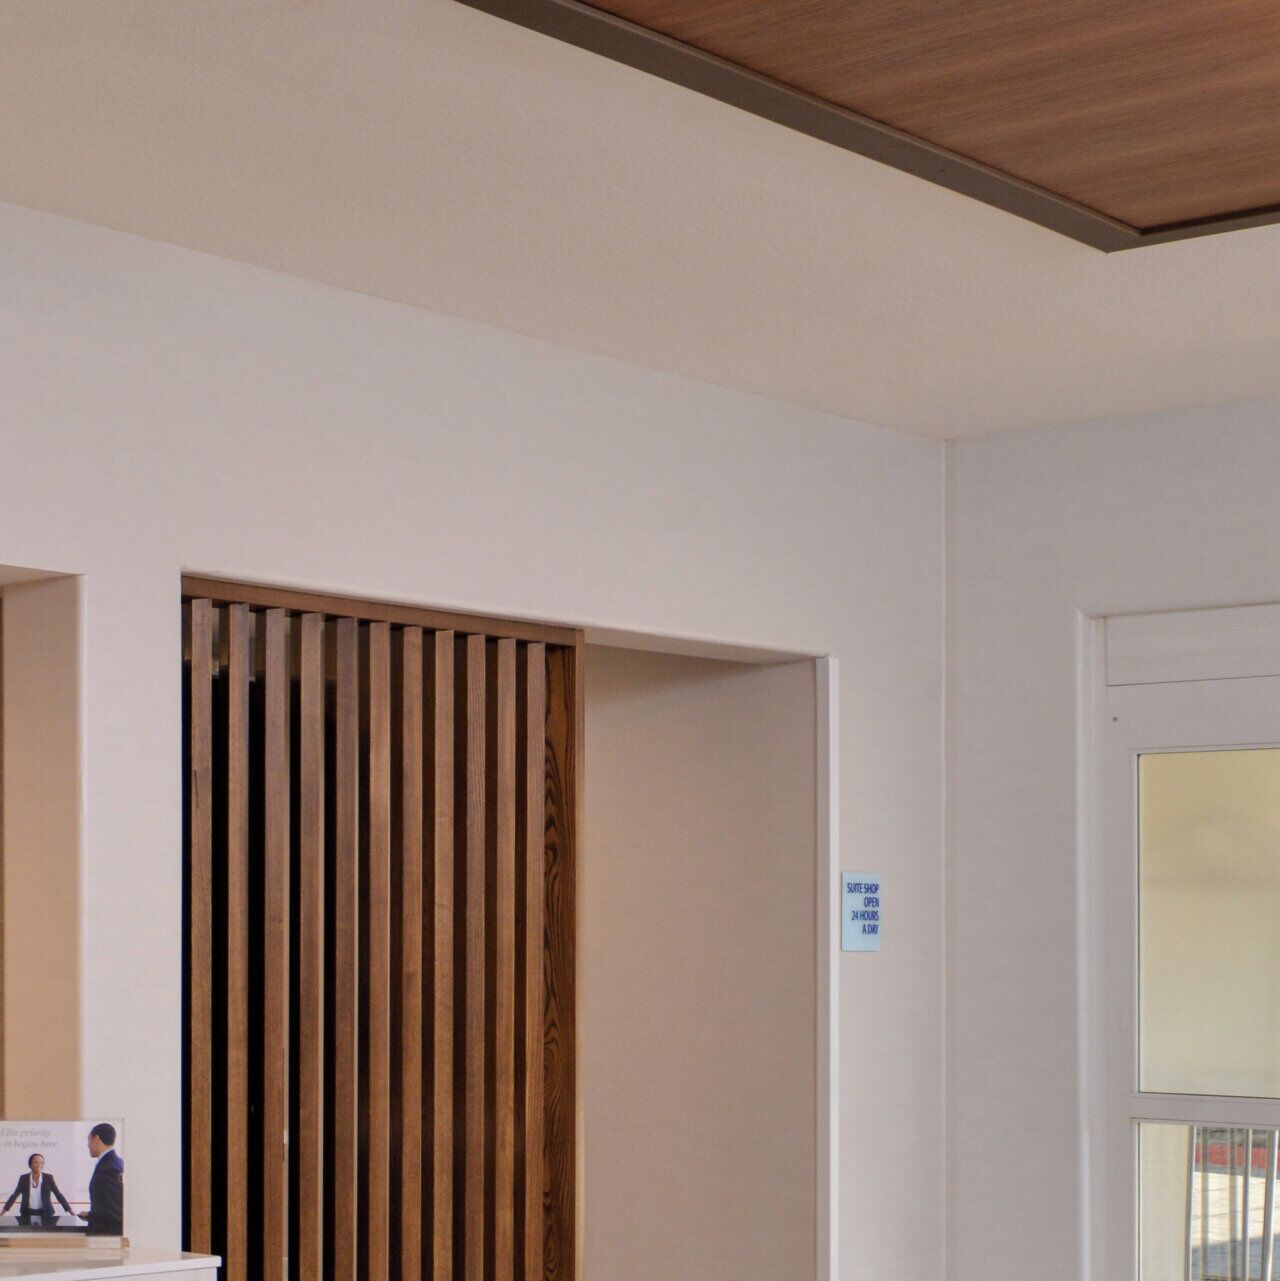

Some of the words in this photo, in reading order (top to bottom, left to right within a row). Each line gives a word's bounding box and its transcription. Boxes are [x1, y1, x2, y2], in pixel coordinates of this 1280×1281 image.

[847, 883, 863, 894] SUITE
[864, 883, 880, 894] SHOP
[864, 897, 880, 908] OPEN
[851, 910, 859, 921] 24
[860, 910, 880, 921] HOURS
[862, 924, 867, 934] A
[868, 924, 879, 934] DAY
